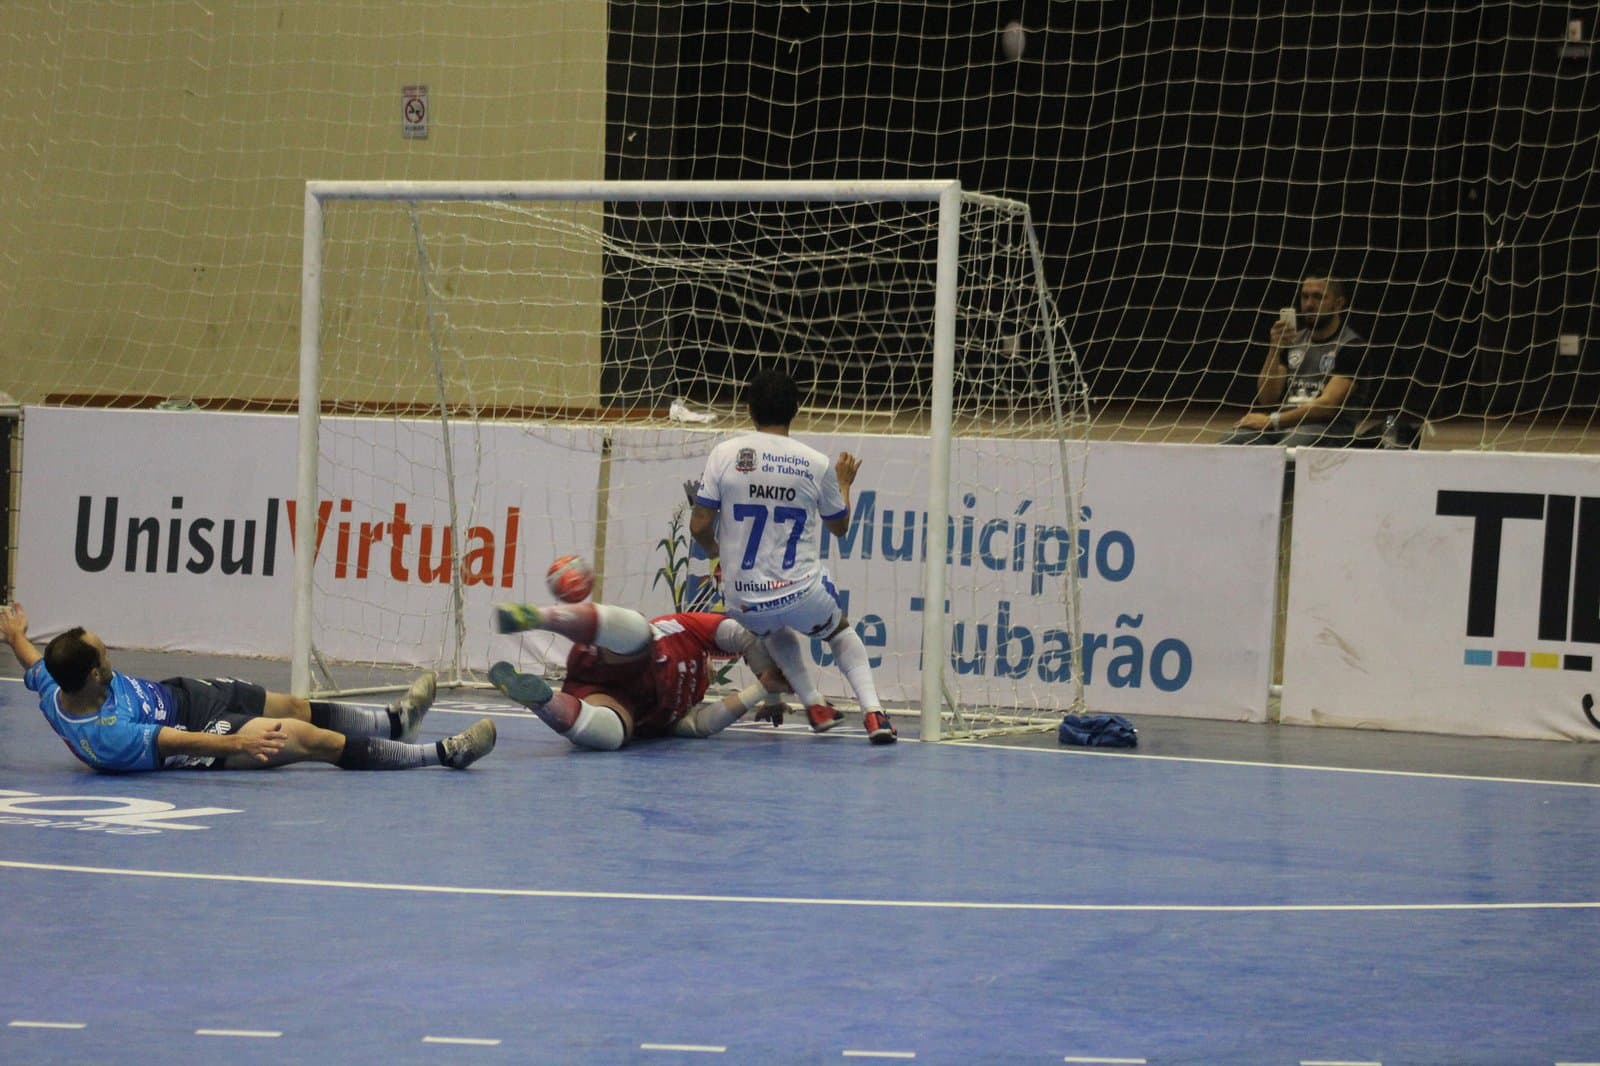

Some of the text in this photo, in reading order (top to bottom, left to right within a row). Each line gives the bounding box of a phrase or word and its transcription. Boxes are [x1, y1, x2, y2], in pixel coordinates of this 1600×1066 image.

[761, 452, 810, 468] Município
[761, 464, 775, 473] de
[749, 484, 796, 502] PAKITO
[75, 495, 521, 589] UnisulVirtual
[733, 503, 808, 570] 77
